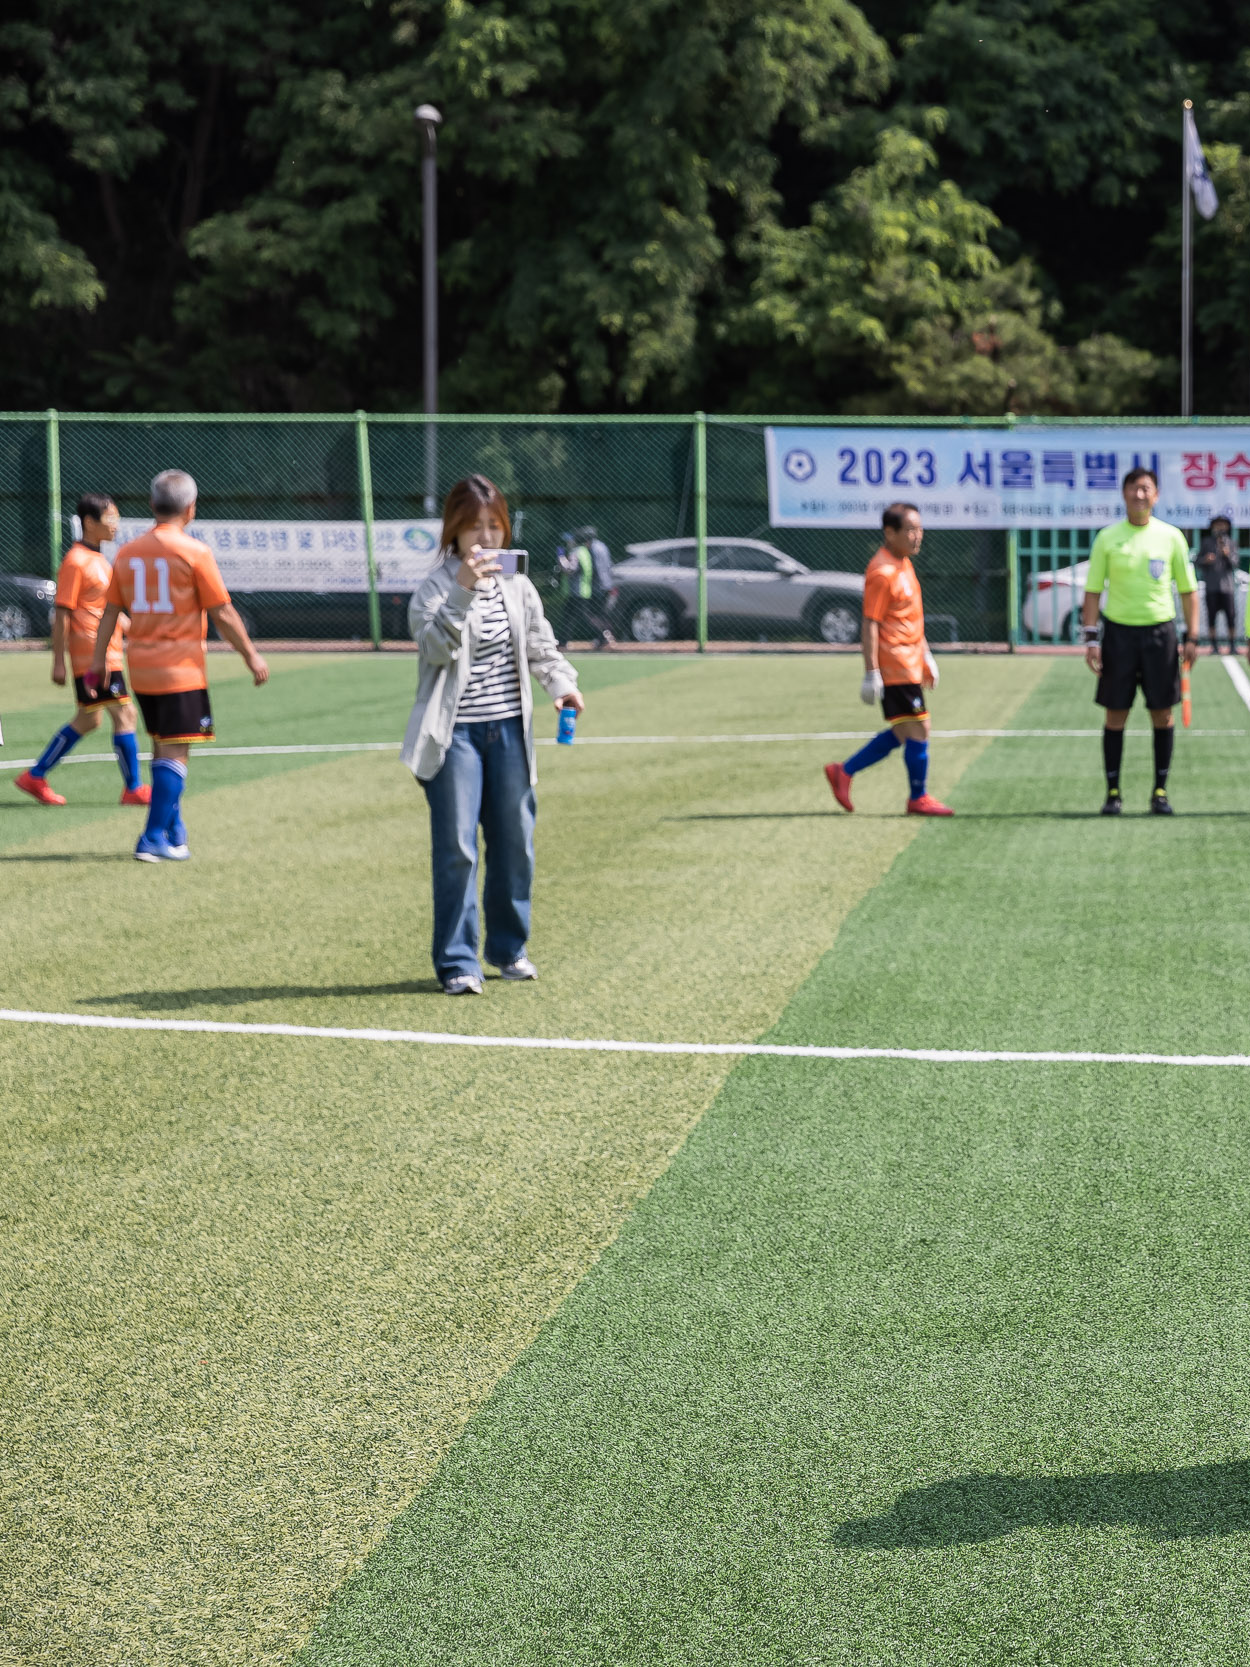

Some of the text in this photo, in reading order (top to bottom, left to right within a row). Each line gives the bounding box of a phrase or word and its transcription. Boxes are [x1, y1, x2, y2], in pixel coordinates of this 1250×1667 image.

[838, 448, 936, 488] 2023
[958, 449, 1162, 489] 서울특별시
[129, 557, 174, 614] 11
